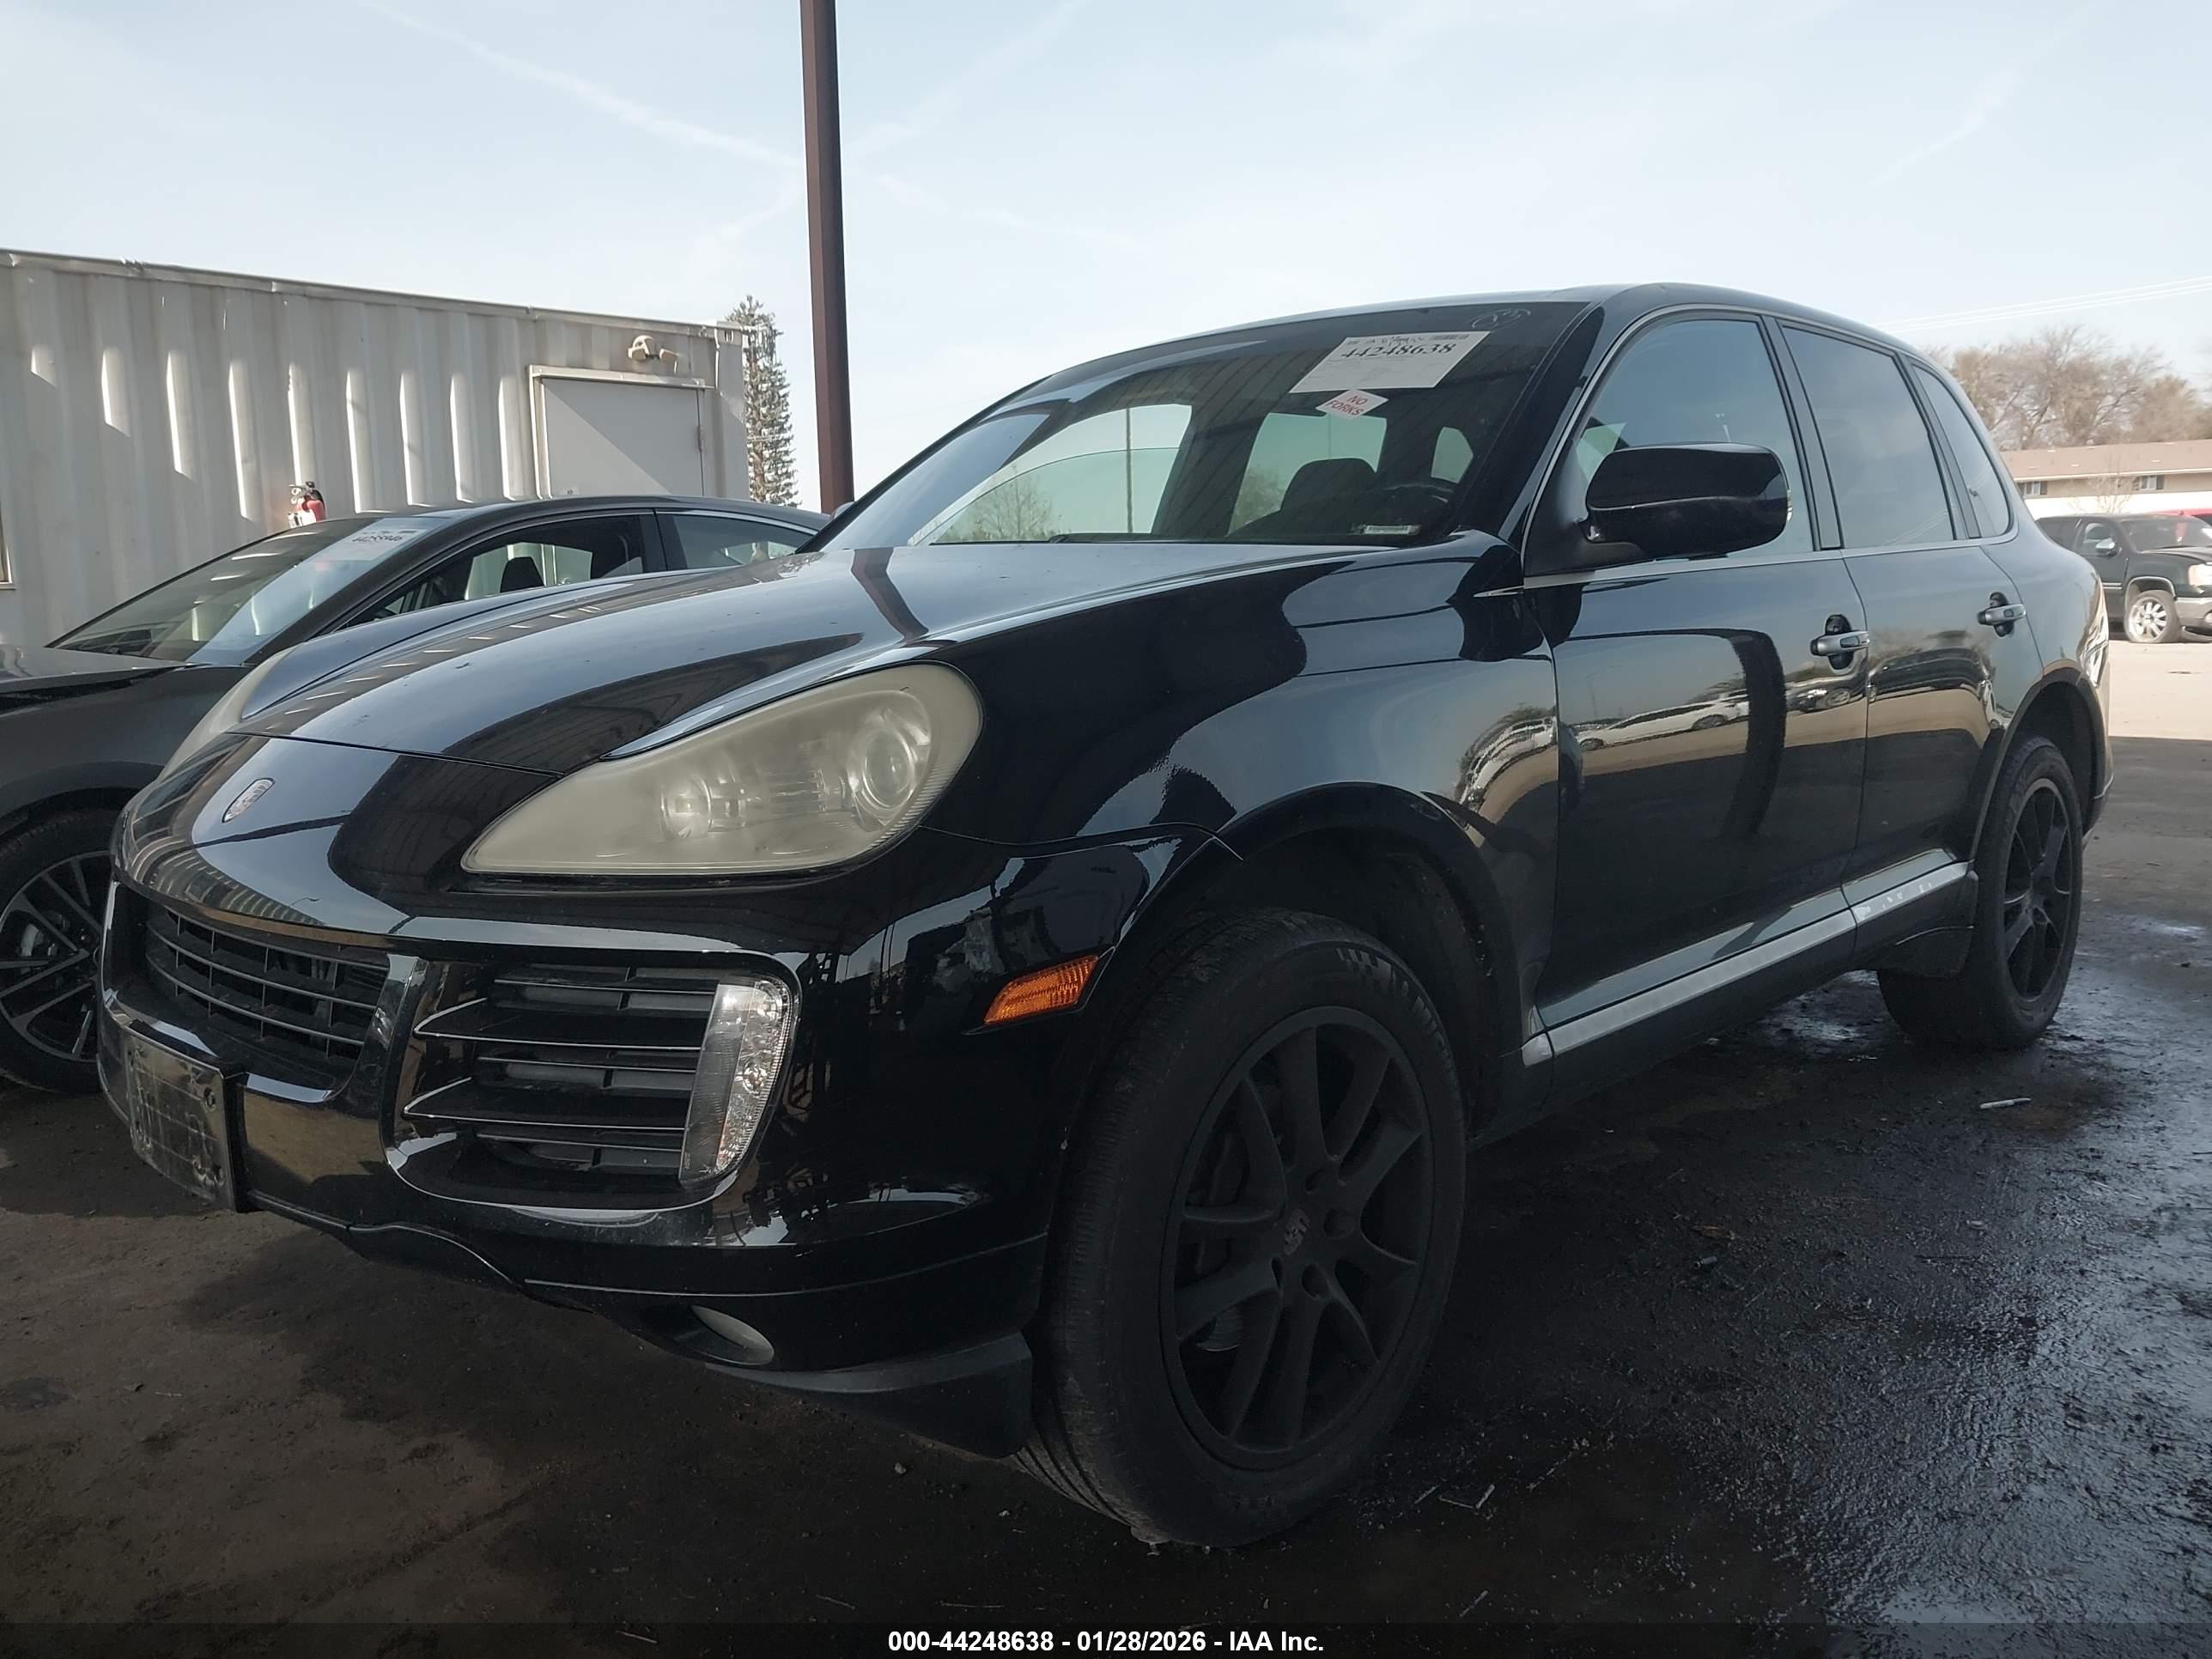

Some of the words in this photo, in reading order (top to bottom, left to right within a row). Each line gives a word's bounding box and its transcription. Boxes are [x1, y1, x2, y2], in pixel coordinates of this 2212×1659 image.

[1342, 343, 1457, 358] 44248638
[1325, 399, 1364, 416] FORKS
[1346, 395, 1368, 405] NO
